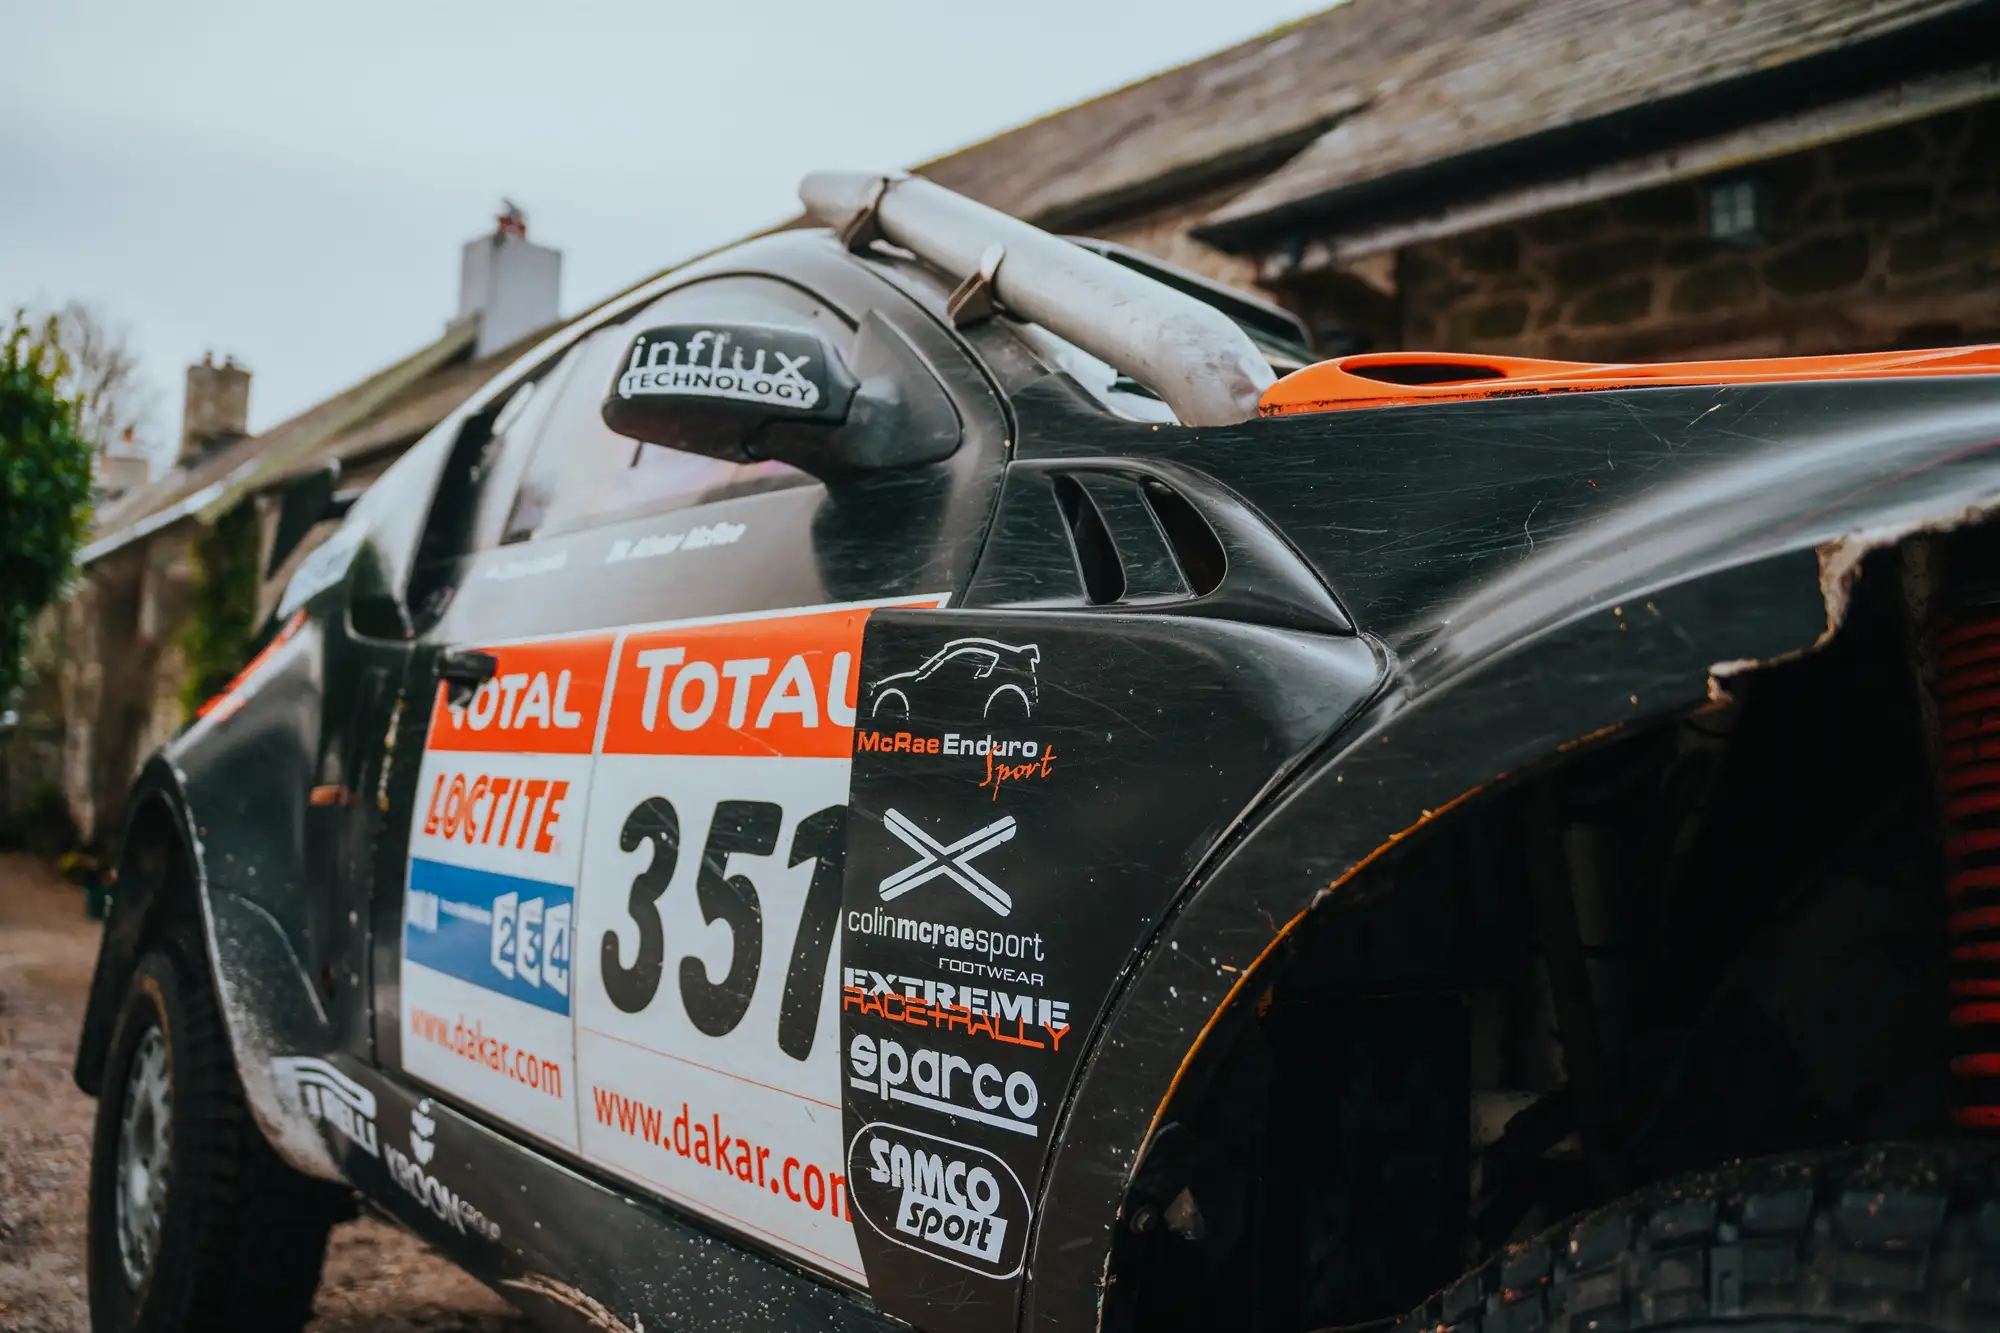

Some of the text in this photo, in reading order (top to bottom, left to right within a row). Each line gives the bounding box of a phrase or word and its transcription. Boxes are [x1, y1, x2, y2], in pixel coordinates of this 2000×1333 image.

[627, 371, 811, 401] TECHNOLOGY
[629, 330, 811, 384] influx
[636, 647, 857, 733] TOTAL
[978, 744, 1057, 802] Sport
[424, 772, 570, 854] LOCTITE
[600, 796, 849, 1062] 351
[844, 967, 1070, 1031] EXTREME
[938, 957, 1045, 988] FOOTWEAR
[410, 1005, 563, 1100] www.dakar.com
[850, 1033, 1039, 1119] sparco
[869, 1138, 1001, 1216] SAMCO
[906, 1201, 993, 1252] sport
